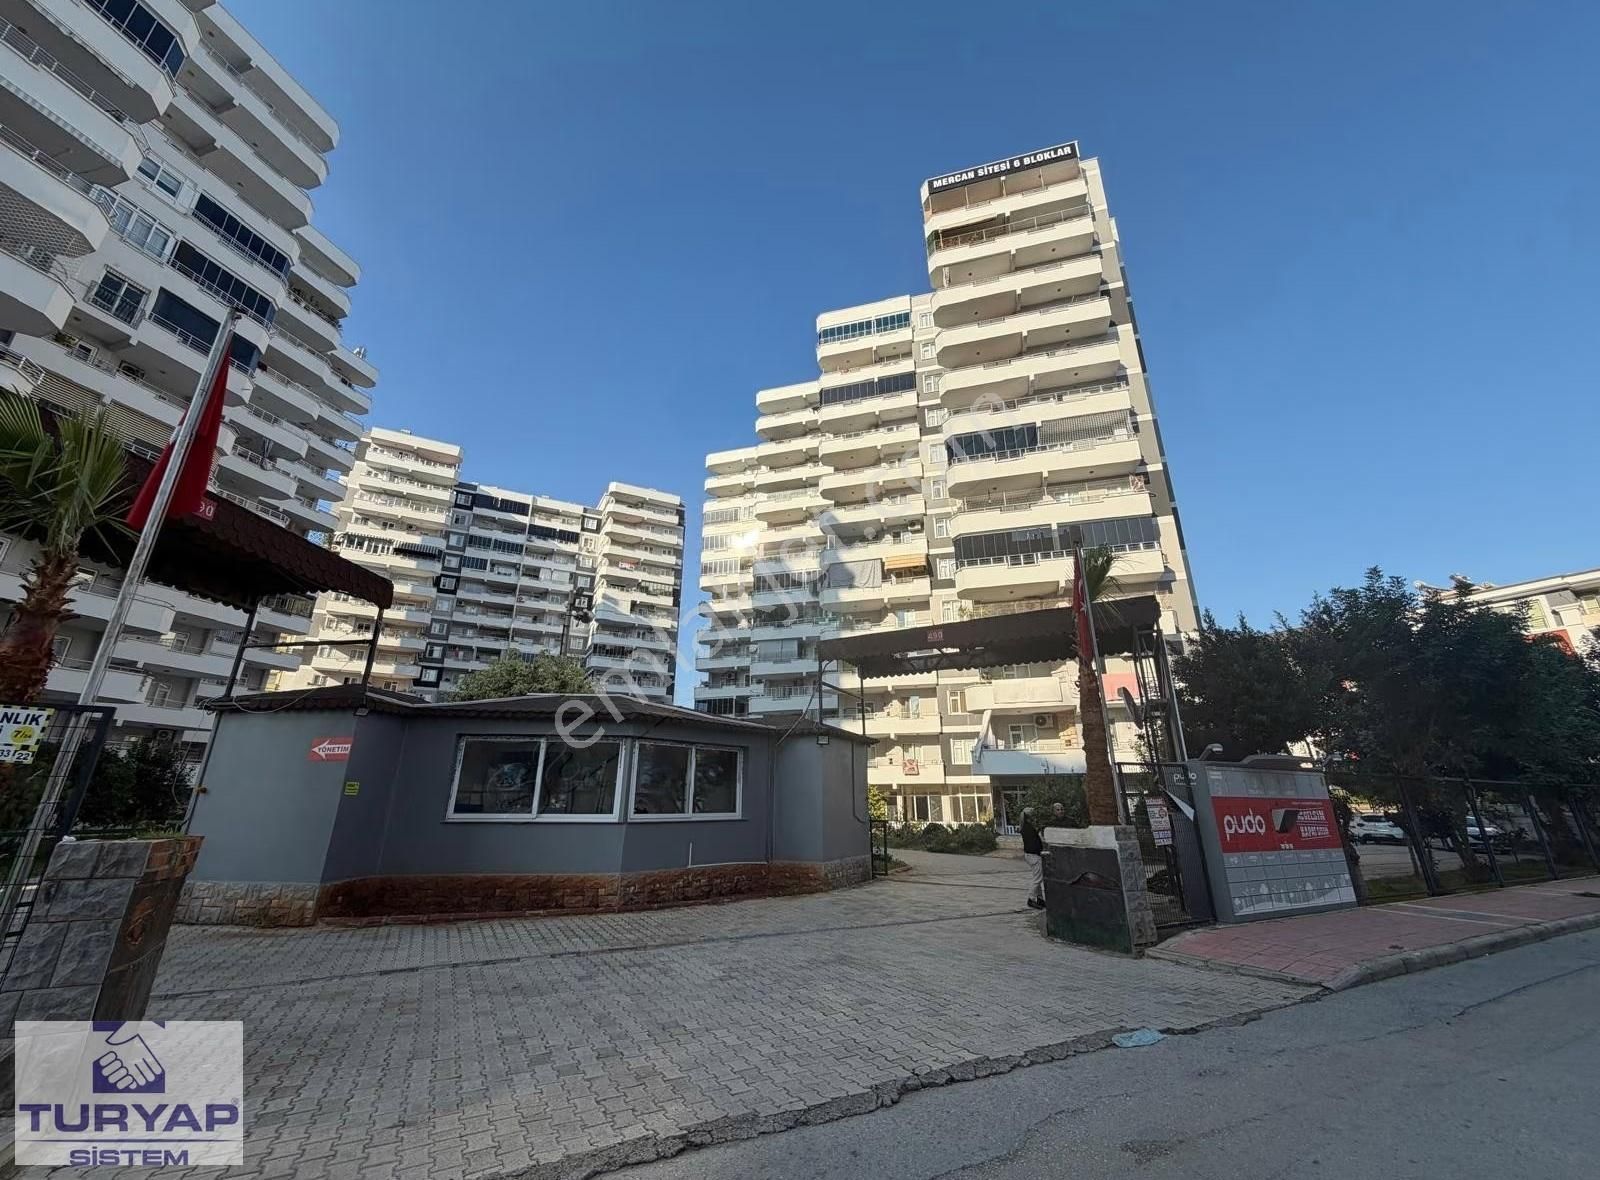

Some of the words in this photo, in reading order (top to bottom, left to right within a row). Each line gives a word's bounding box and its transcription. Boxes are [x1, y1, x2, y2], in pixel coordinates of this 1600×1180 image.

[933, 171, 975, 188] MERCAN
[977, 160, 1011, 177] SİTESİ
[1013, 159, 1021, 168] 6
[1023, 146, 1072, 165] BLOKLAR
[1224, 808, 1266, 842] pudo
